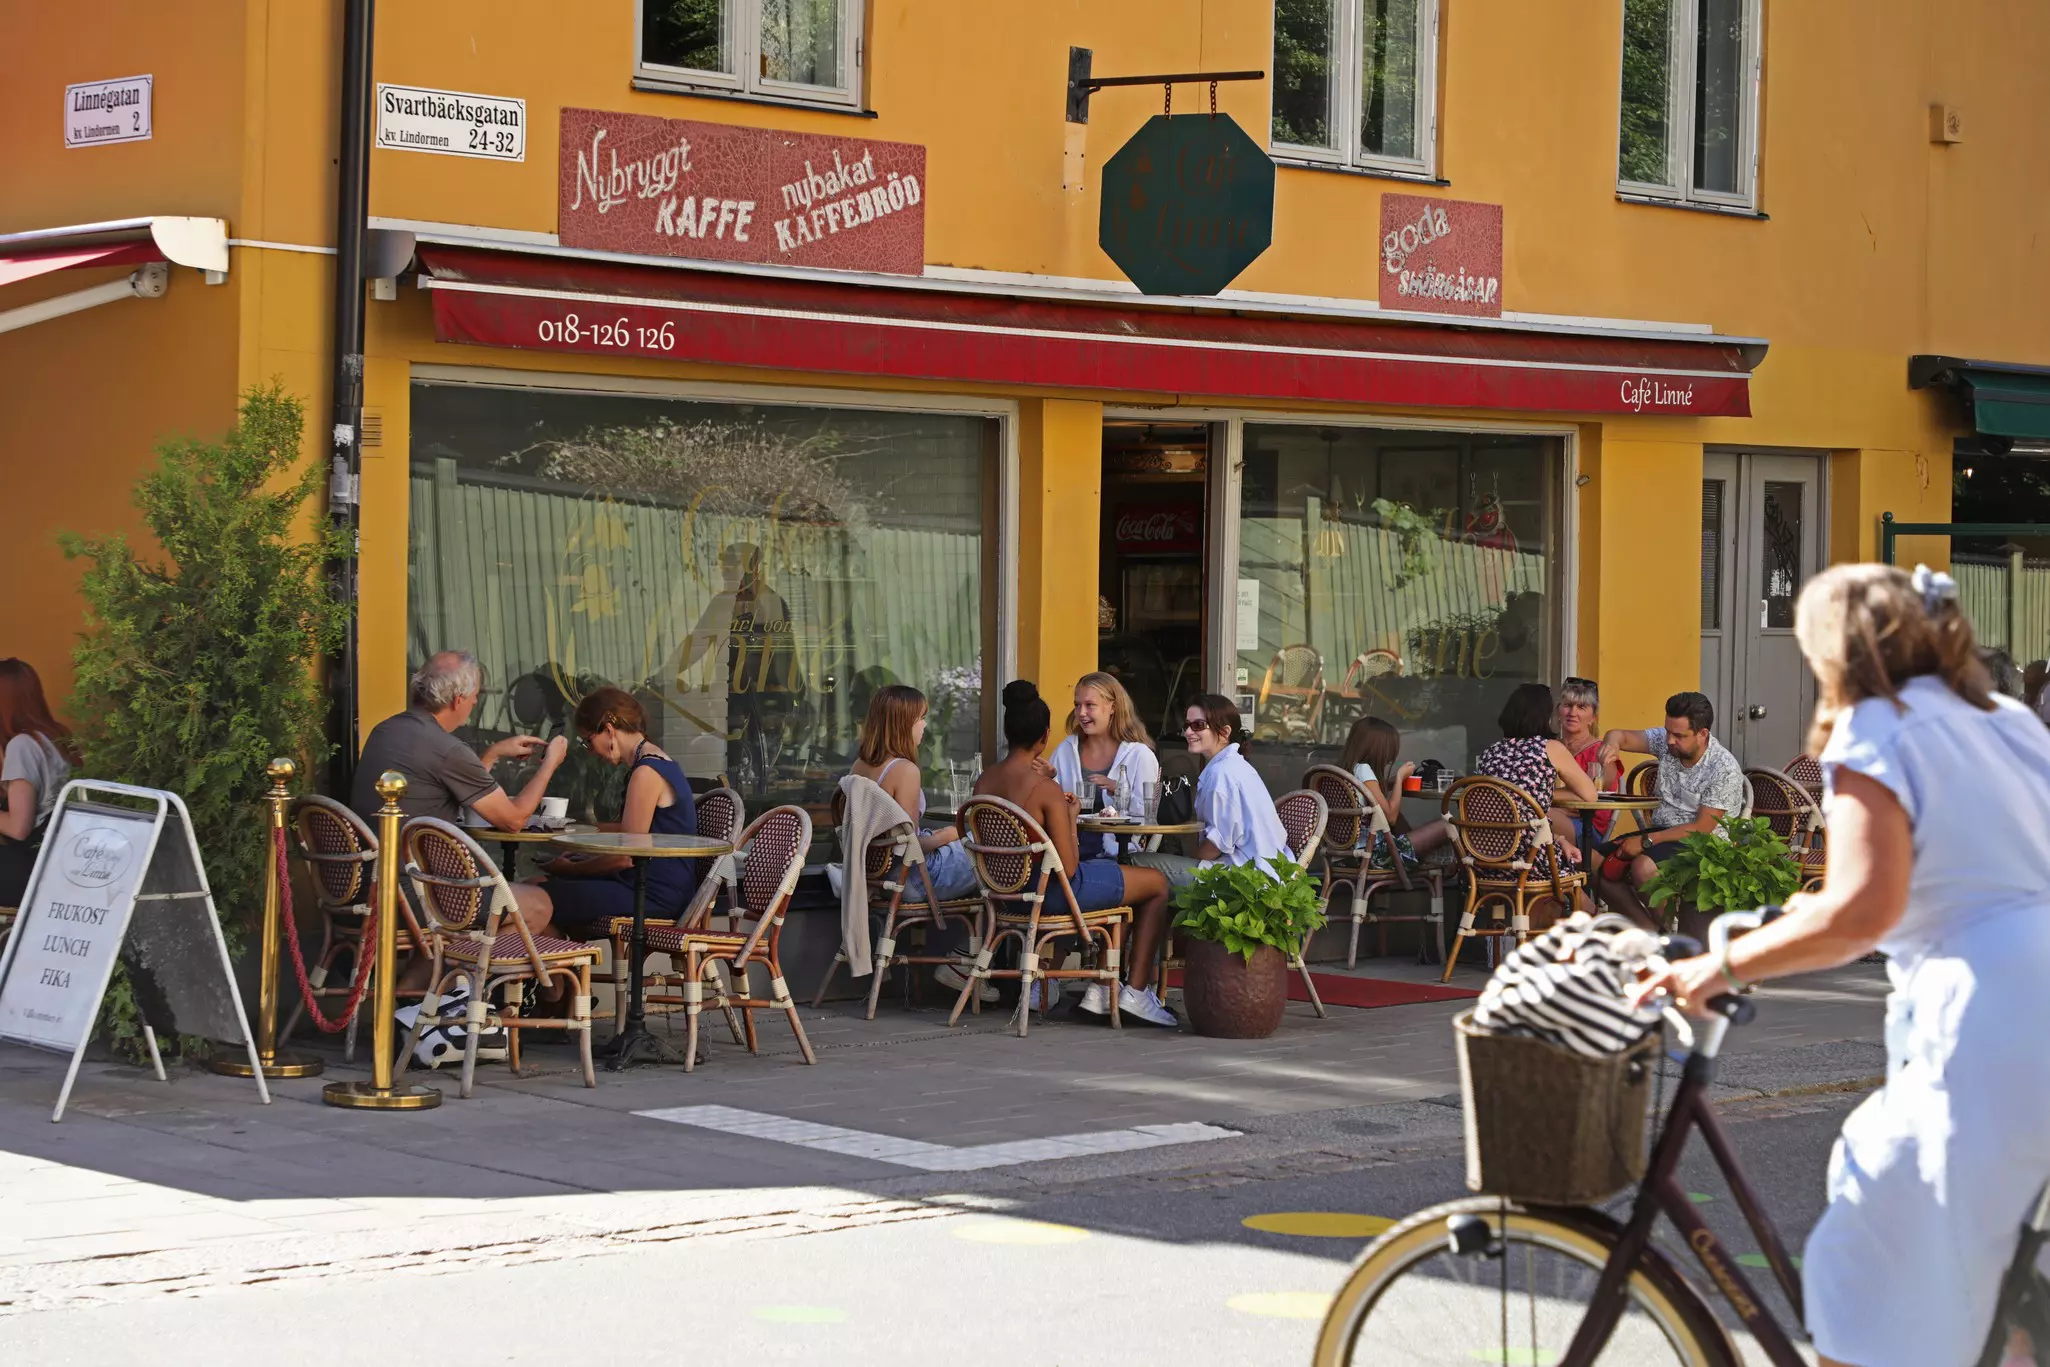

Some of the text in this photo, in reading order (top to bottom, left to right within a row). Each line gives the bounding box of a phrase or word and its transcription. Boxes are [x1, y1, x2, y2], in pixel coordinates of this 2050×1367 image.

[74, 86, 140, 113] Linnégatan
[385, 92, 519, 127] Svartbäcksgatan
[84, 124, 120, 138] Lindormen
[133, 111, 140, 132] 2
[385, 128, 514, 153] kv. Lindormen 24-32
[571, 128, 692, 213] Nybryggt
[781, 147, 876, 211] nybakat
[656, 195, 755, 243] KAFFE
[773, 171, 922, 253] KAFFEBRÖD
[1383, 203, 1451, 273] goda
[538, 313, 675, 351] 018-126 126
[1621, 377, 1693, 412] Café Linné
[48, 902, 110, 925] FRUKOST
[42, 934, 91, 957] LUNCH
[40, 968, 71, 988] FIKA
